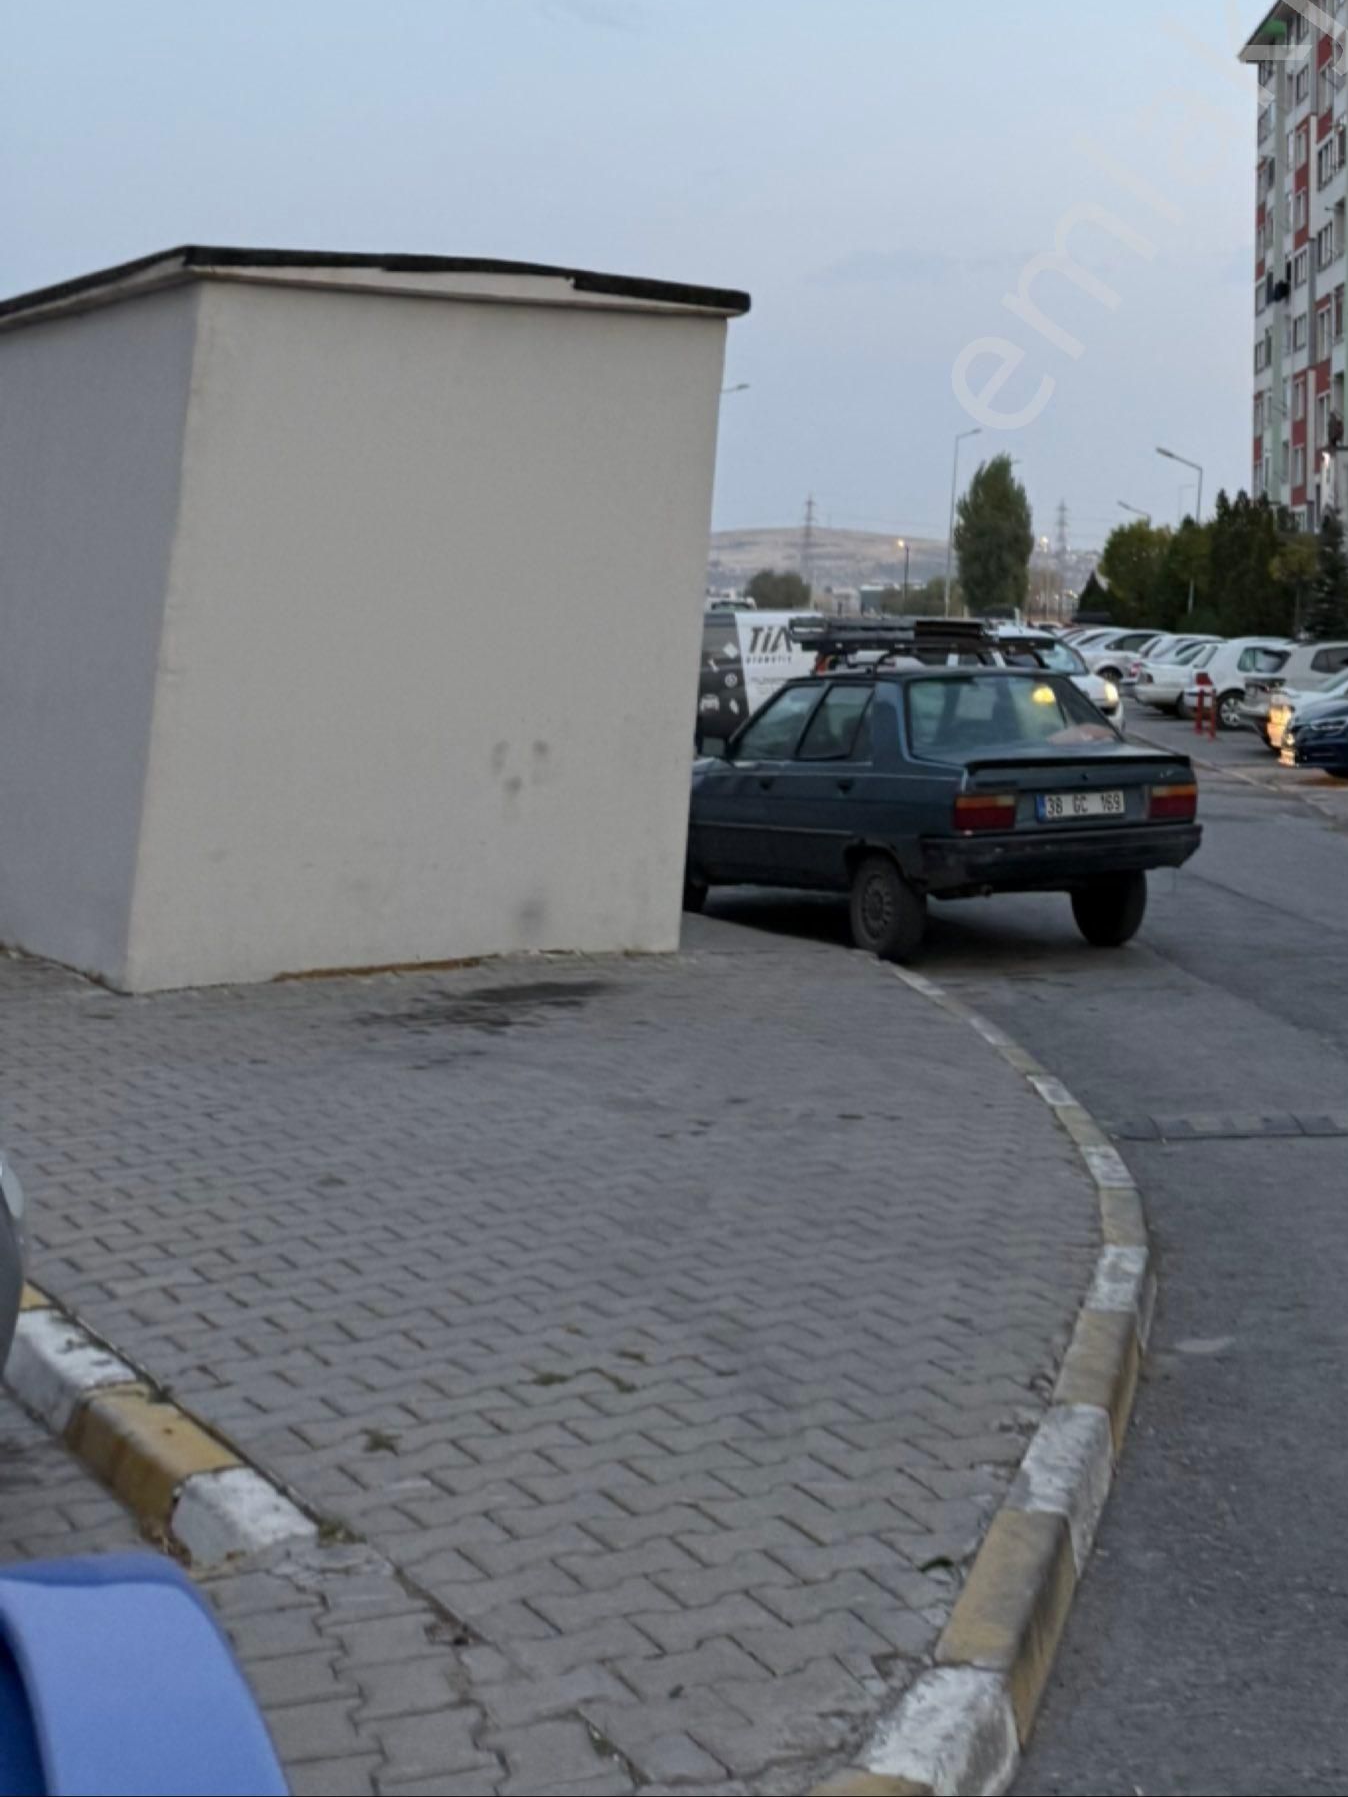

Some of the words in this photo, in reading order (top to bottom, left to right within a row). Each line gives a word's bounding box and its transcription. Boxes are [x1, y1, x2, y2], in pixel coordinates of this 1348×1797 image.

[1047, 796, 1063, 815] 38
[1073, 794, 1089, 813] GC
[1100, 793, 1121, 811] 169
